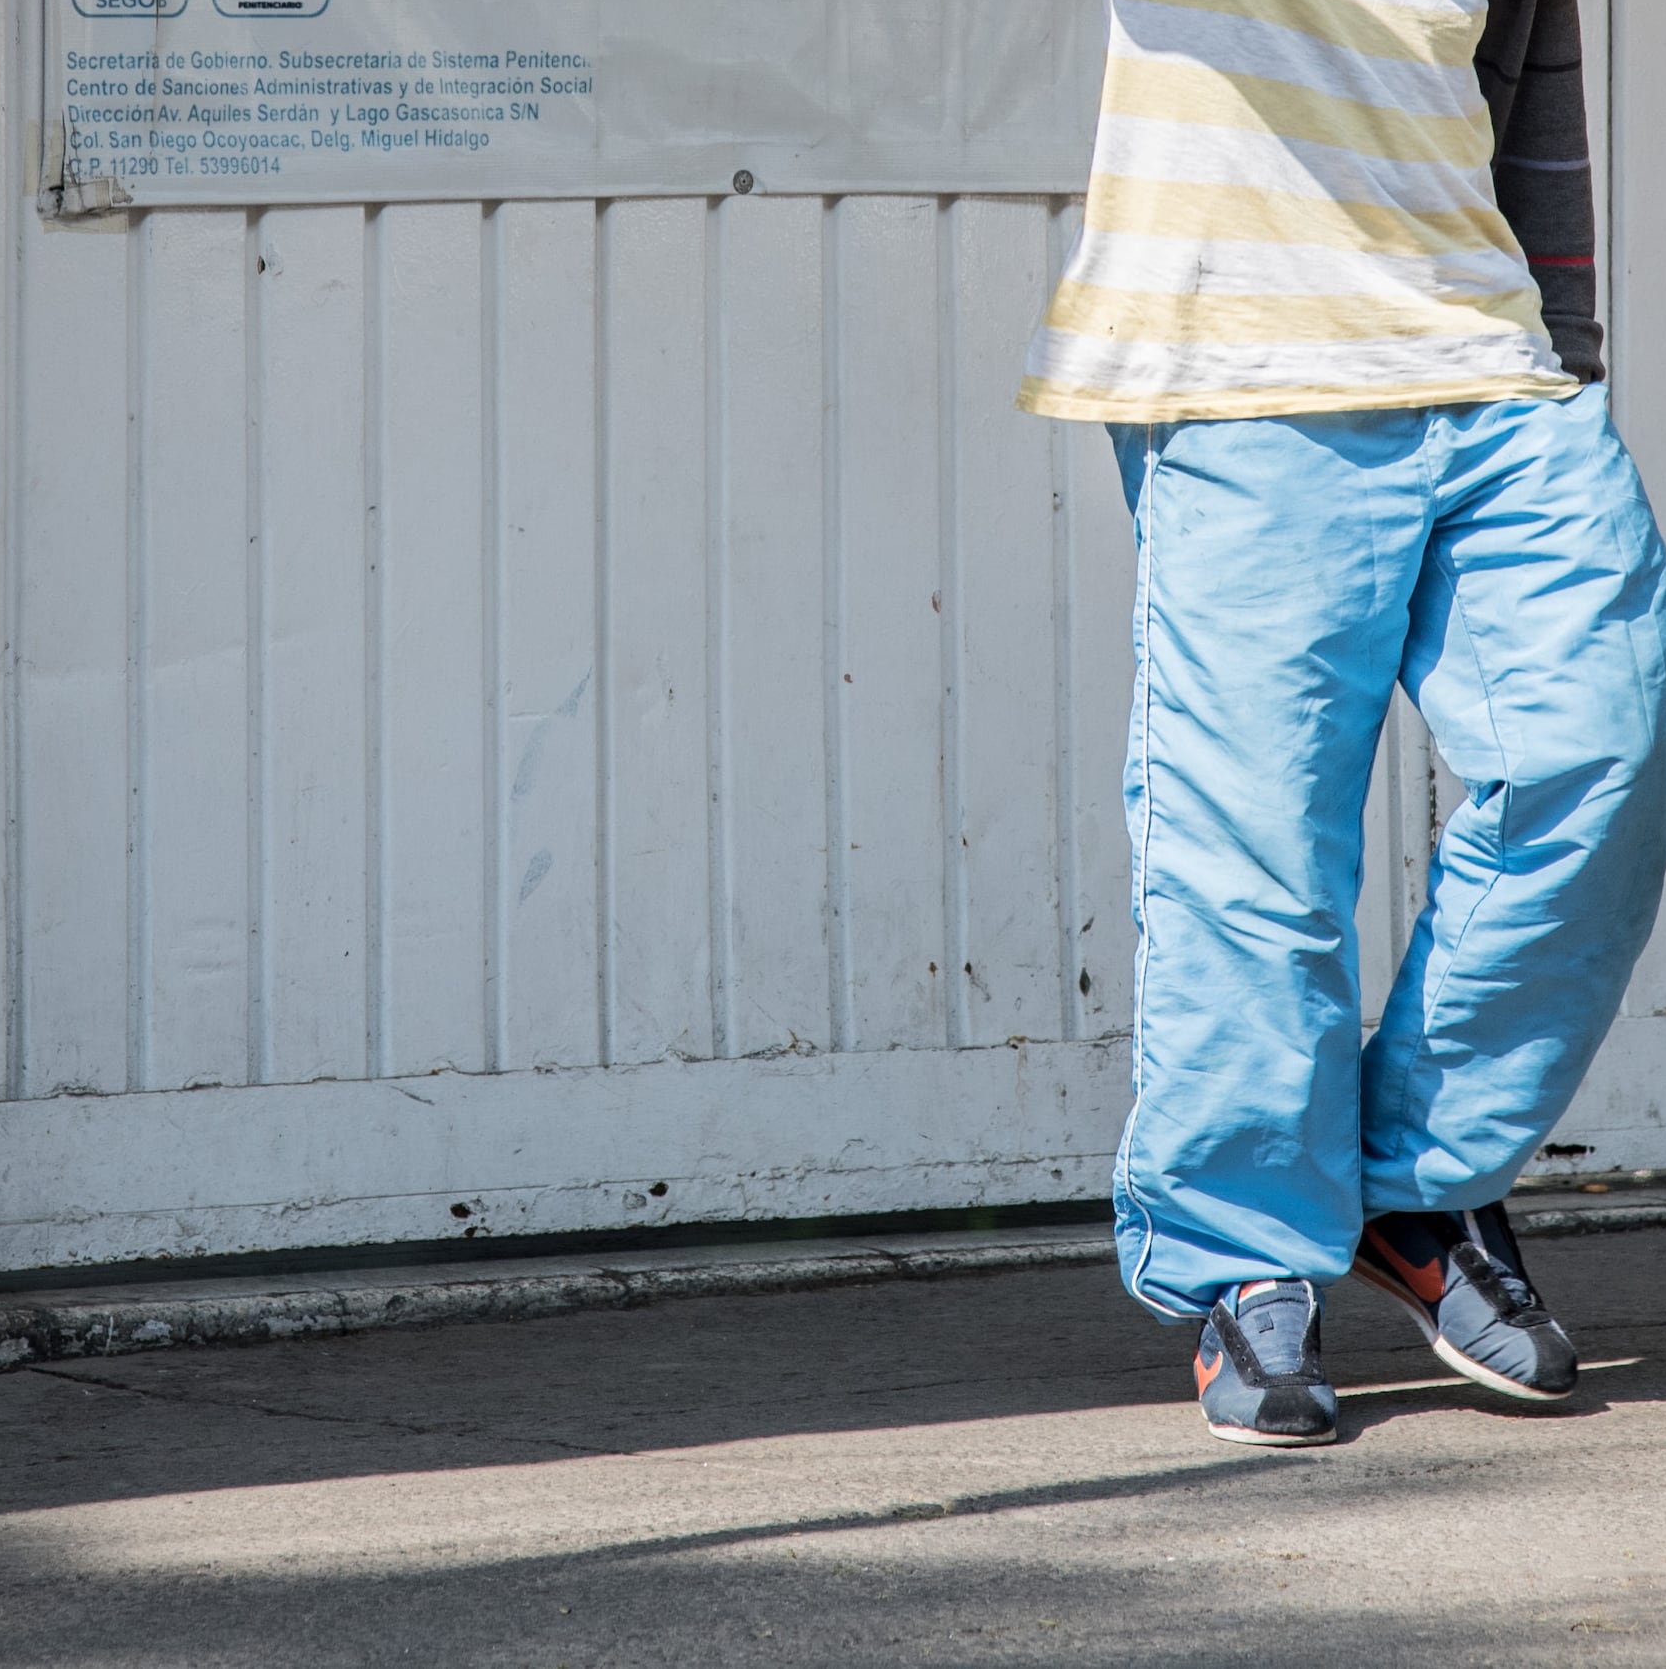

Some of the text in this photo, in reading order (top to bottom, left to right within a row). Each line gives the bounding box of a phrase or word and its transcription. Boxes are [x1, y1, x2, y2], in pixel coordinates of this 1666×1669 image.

[238, 1, 303, 9] PENITENCIARIO
[67, 51, 159, 70] Secretaria
[166, 52, 184, 69] de
[191, 51, 272, 69] Gobierno.
[279, 50, 401, 69] Subsecretaria
[407, 51, 426, 69] de
[432, 50, 499, 69] Sistema
[67, 76, 593, 98] Centro de Sanciones Administrativas y de Integración Social
[68, 104, 154, 124] Dirección
[157, 105, 182, 123] Av.
[188, 104, 251, 126] Aquiles
[257, 103, 319, 123] Serdán
[330, 111, 339, 125] y
[346, 103, 389, 125] Lago
[510, 103, 539, 121] S/N
[70, 129, 490, 153] Col. San Diego Ocoyoacac, Delg. Miguel Hidalgo
[110, 157, 159, 175] 11290
[165, 157, 194, 175] Tel.
[200, 156, 280, 175] 53996014
